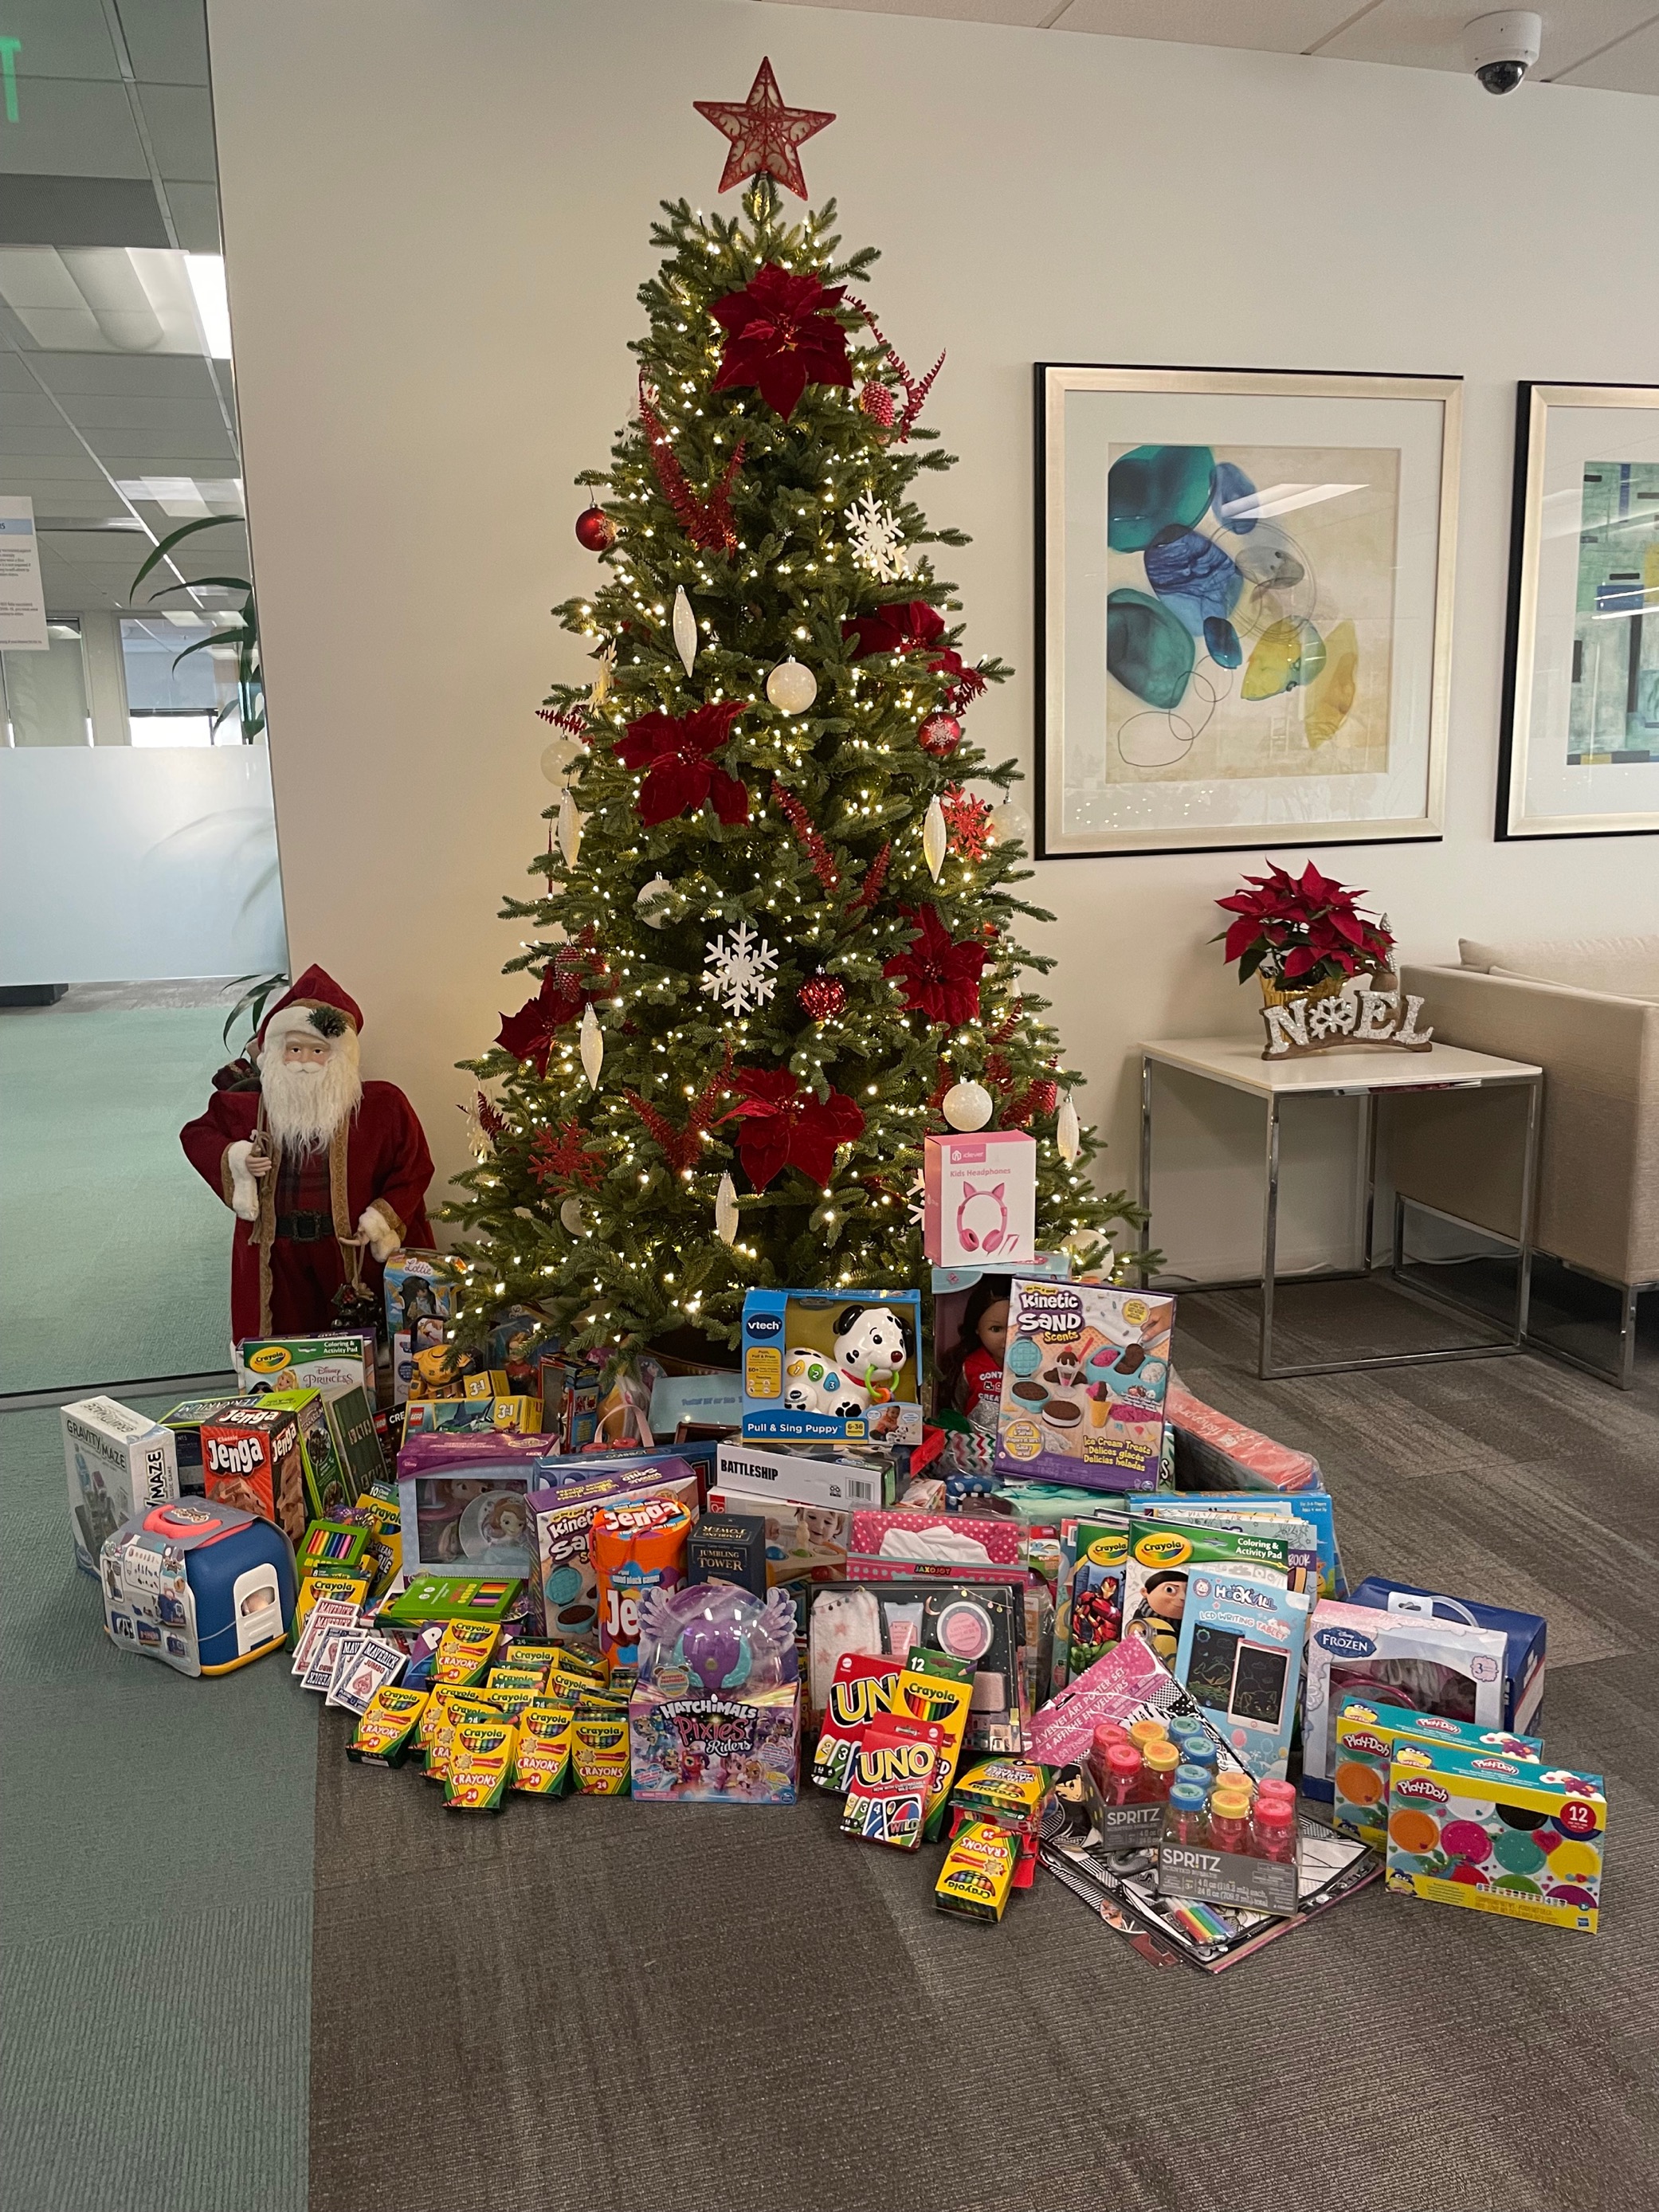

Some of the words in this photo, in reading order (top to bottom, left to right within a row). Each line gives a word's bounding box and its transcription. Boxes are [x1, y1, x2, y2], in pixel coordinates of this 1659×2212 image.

[967, 1168, 1011, 1178] Headphones
[404, 1259, 432, 1275] Lottie
[1021, 1293, 1079, 1309] Kinetic
[1044, 1331, 1079, 1343] Scents
[255, 1351, 284, 1363] Crayola
[794, 1366, 801, 1375] 1
[813, 1371, 820, 1379] 2
[303, 1373, 354, 1389] PRINCESS
[830, 1381, 835, 1390] 3
[218, 1409, 279, 1425] Jenga
[410, 1411, 423, 1421] LEGO
[375, 1419, 387, 1429] LEGO
[747, 1423, 767, 1432] Pull
[779, 1423, 802, 1433] Sing
[806, 1424, 838, 1434] Puppy
[66, 1419, 102, 1450] GRAVITY
[272, 1422, 297, 1464] Jenga
[1083, 1434, 1096, 1447] Ice
[1097, 1435, 1123, 1449] Cream
[1124, 1440, 1152, 1456] Treats
[101, 1444, 127, 1469] MAZE
[207, 1436, 265, 1474] Jenga
[720, 1459, 779, 1481] BATTLESHIP
[1084, 1453, 1114, 1465] Delicias
[1115, 1457, 1146, 1473] heladas
[147, 1450, 166, 1500] MAZE
[370, 1486, 378, 1497] 10
[603, 1500, 682, 1532] Jenga
[1095, 1542, 1127, 1553] Crayola
[1143, 1540, 1183, 1554] Crayola
[1237, 1537, 1272, 1551] Coloring
[700, 1548, 739, 1559] JUMBLING
[1235, 1546, 1266, 1560] Activity
[1267, 1551, 1282, 1559] Pad
[697, 1557, 743, 1571] TOWER
[314, 1580, 353, 1591] Crayola
[455, 1622, 492, 1634] Crayola
[1199, 1610, 1217, 1620] LCD
[1218, 1611, 1255, 1628] WRITING
[1256, 1621, 1288, 1641] TABLET
[1322, 1634, 1368, 1653] FROZEN
[363, 1642, 400, 1669] MAVERICK
[514, 1650, 551, 1661] Crayola
[363, 1659, 386, 1675] JUMBO
[438, 1657, 479, 1671] CRAYONS
[911, 1656, 925, 1673] 12
[1474, 1662, 1484, 1674] 3
[448, 1669, 459, 1679] 24
[555, 1674, 588, 1690] Crayola
[382, 1689, 418, 1702] Crayola
[491, 1692, 529, 1703] Crayola
[908, 1681, 956, 1703] Crayola
[831, 1673, 898, 1727] UN
[1041, 1714, 1069, 1740] VELVET
[1068, 1701, 1084, 1719] ART
[1083, 1678, 1112, 1704] POSTER
[1111, 1666, 1126, 1682] SET
[530, 1712, 568, 1725] Crayola
[1052, 1717, 1084, 1747] AFFICHE
[1082, 1709, 1095, 1720] EN
[1094, 1679, 1129, 1711] VELOURS
[360, 1724, 401, 1739] CRAYONS
[579, 1726, 621, 1737] Crayola
[1418, 1717, 1461, 1734] Play-Doh
[464, 1728, 504, 1739] Crayola
[368, 1738, 379, 1747] 24
[706, 1740, 753, 1757] Riders
[821, 1741, 832, 1755] 2
[1343, 1734, 1391, 1758] Play-Doh
[837, 1747, 849, 1760] 3
[518, 1757, 559, 1774] CRAYONS
[857, 1743, 935, 1786] UNO
[1473, 1759, 1519, 1775] Play-Doh
[529, 1775, 541, 1784] 24
[579, 1767, 624, 1778] CRAYONS
[452, 1774, 497, 1787] CRAYONS
[597, 1781, 608, 1790] 24
[467, 1790, 478, 1800] 24
[971, 1783, 1020, 1798] Crayola
[1396, 1779, 1449, 1804] Play-Doh
[861, 1802, 868, 1813] 3
[873, 1804, 881, 1814] 4
[1568, 1805, 1589, 1824] 12
[889, 1819, 920, 1834] WILD
[982, 1830, 994, 1839] 24
[960, 1836, 1009, 1858] CRAYONS
[947, 1880, 991, 1900] Crayola
[1197, 1886, 1206, 1895] 24
[1253, 1896, 1269, 1908] total
